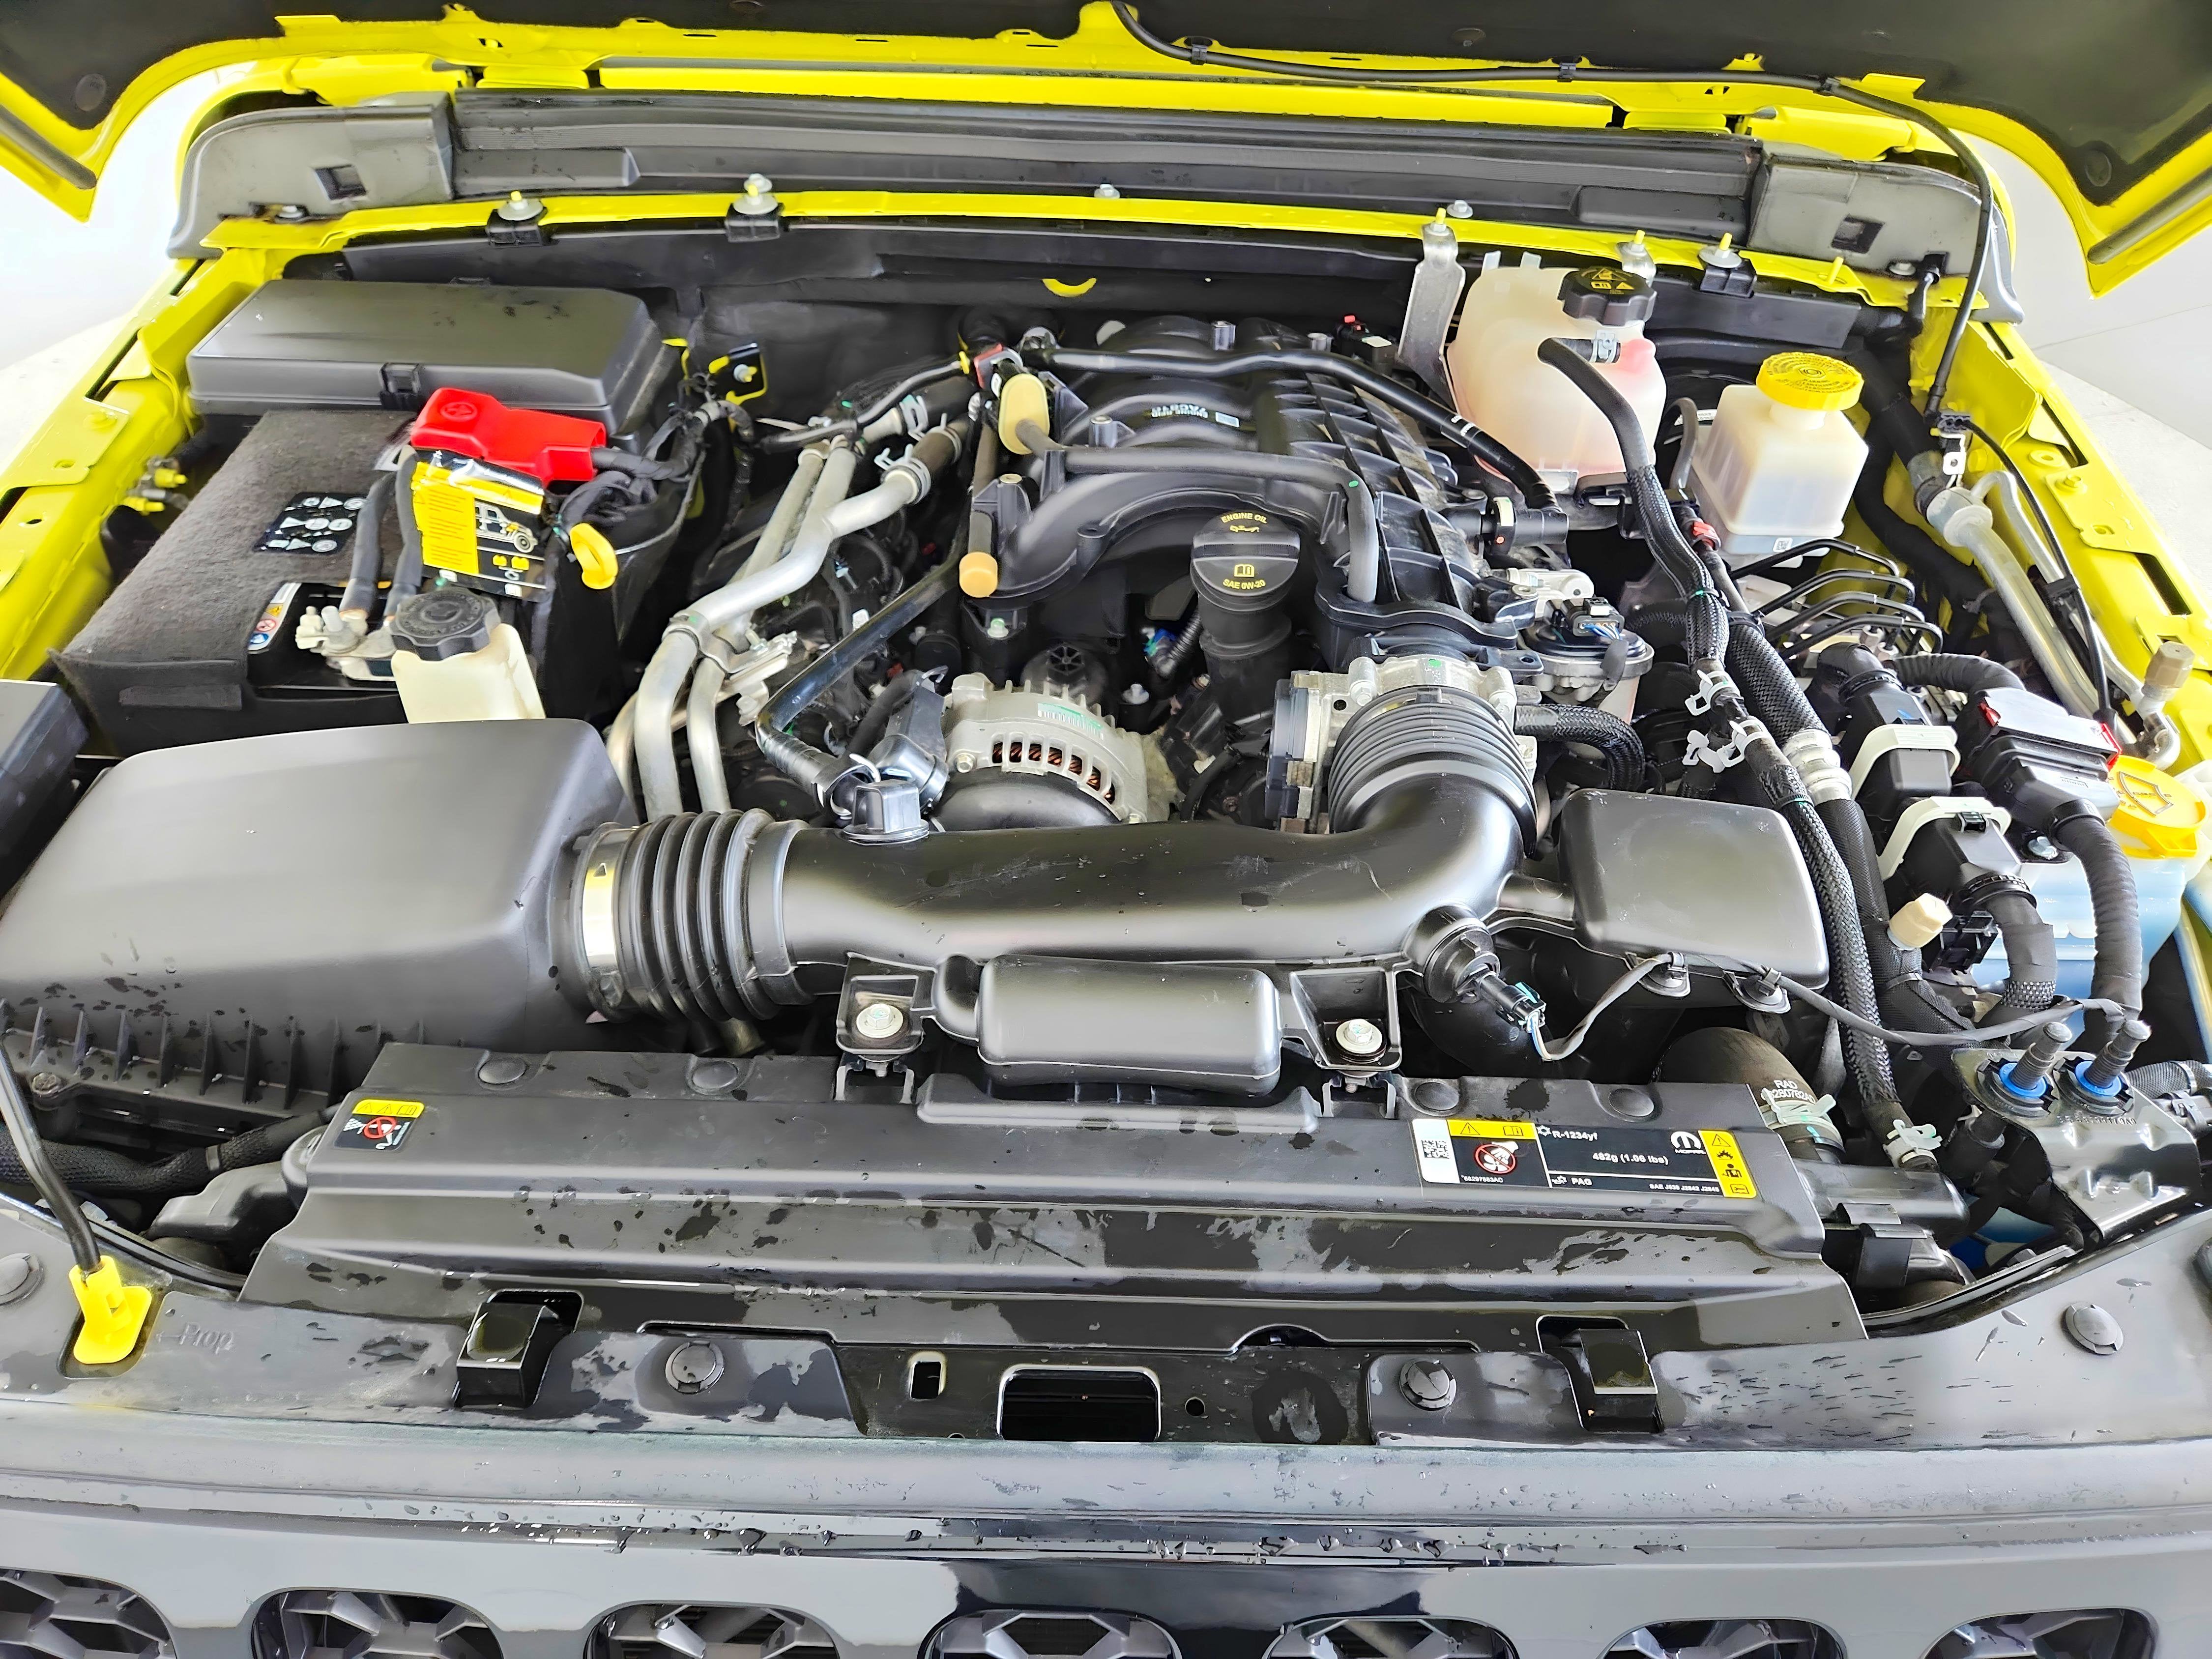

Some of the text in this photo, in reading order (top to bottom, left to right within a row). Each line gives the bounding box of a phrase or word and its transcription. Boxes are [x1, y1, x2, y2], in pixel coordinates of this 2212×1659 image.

[1221, 512, 1267, 524] ENGINE OIL
[1222, 579, 1266, 590] SAE 0W-20
[1774, 1079, 1798, 1089] RAD
[1552, 1131, 1598, 1141] R-1234yf
[1592, 1152, 1669, 1165] 482g (1.06 lbs)
[1572, 1177, 1593, 1186] PAG
[179, 1322, 233, 1355] Prop
